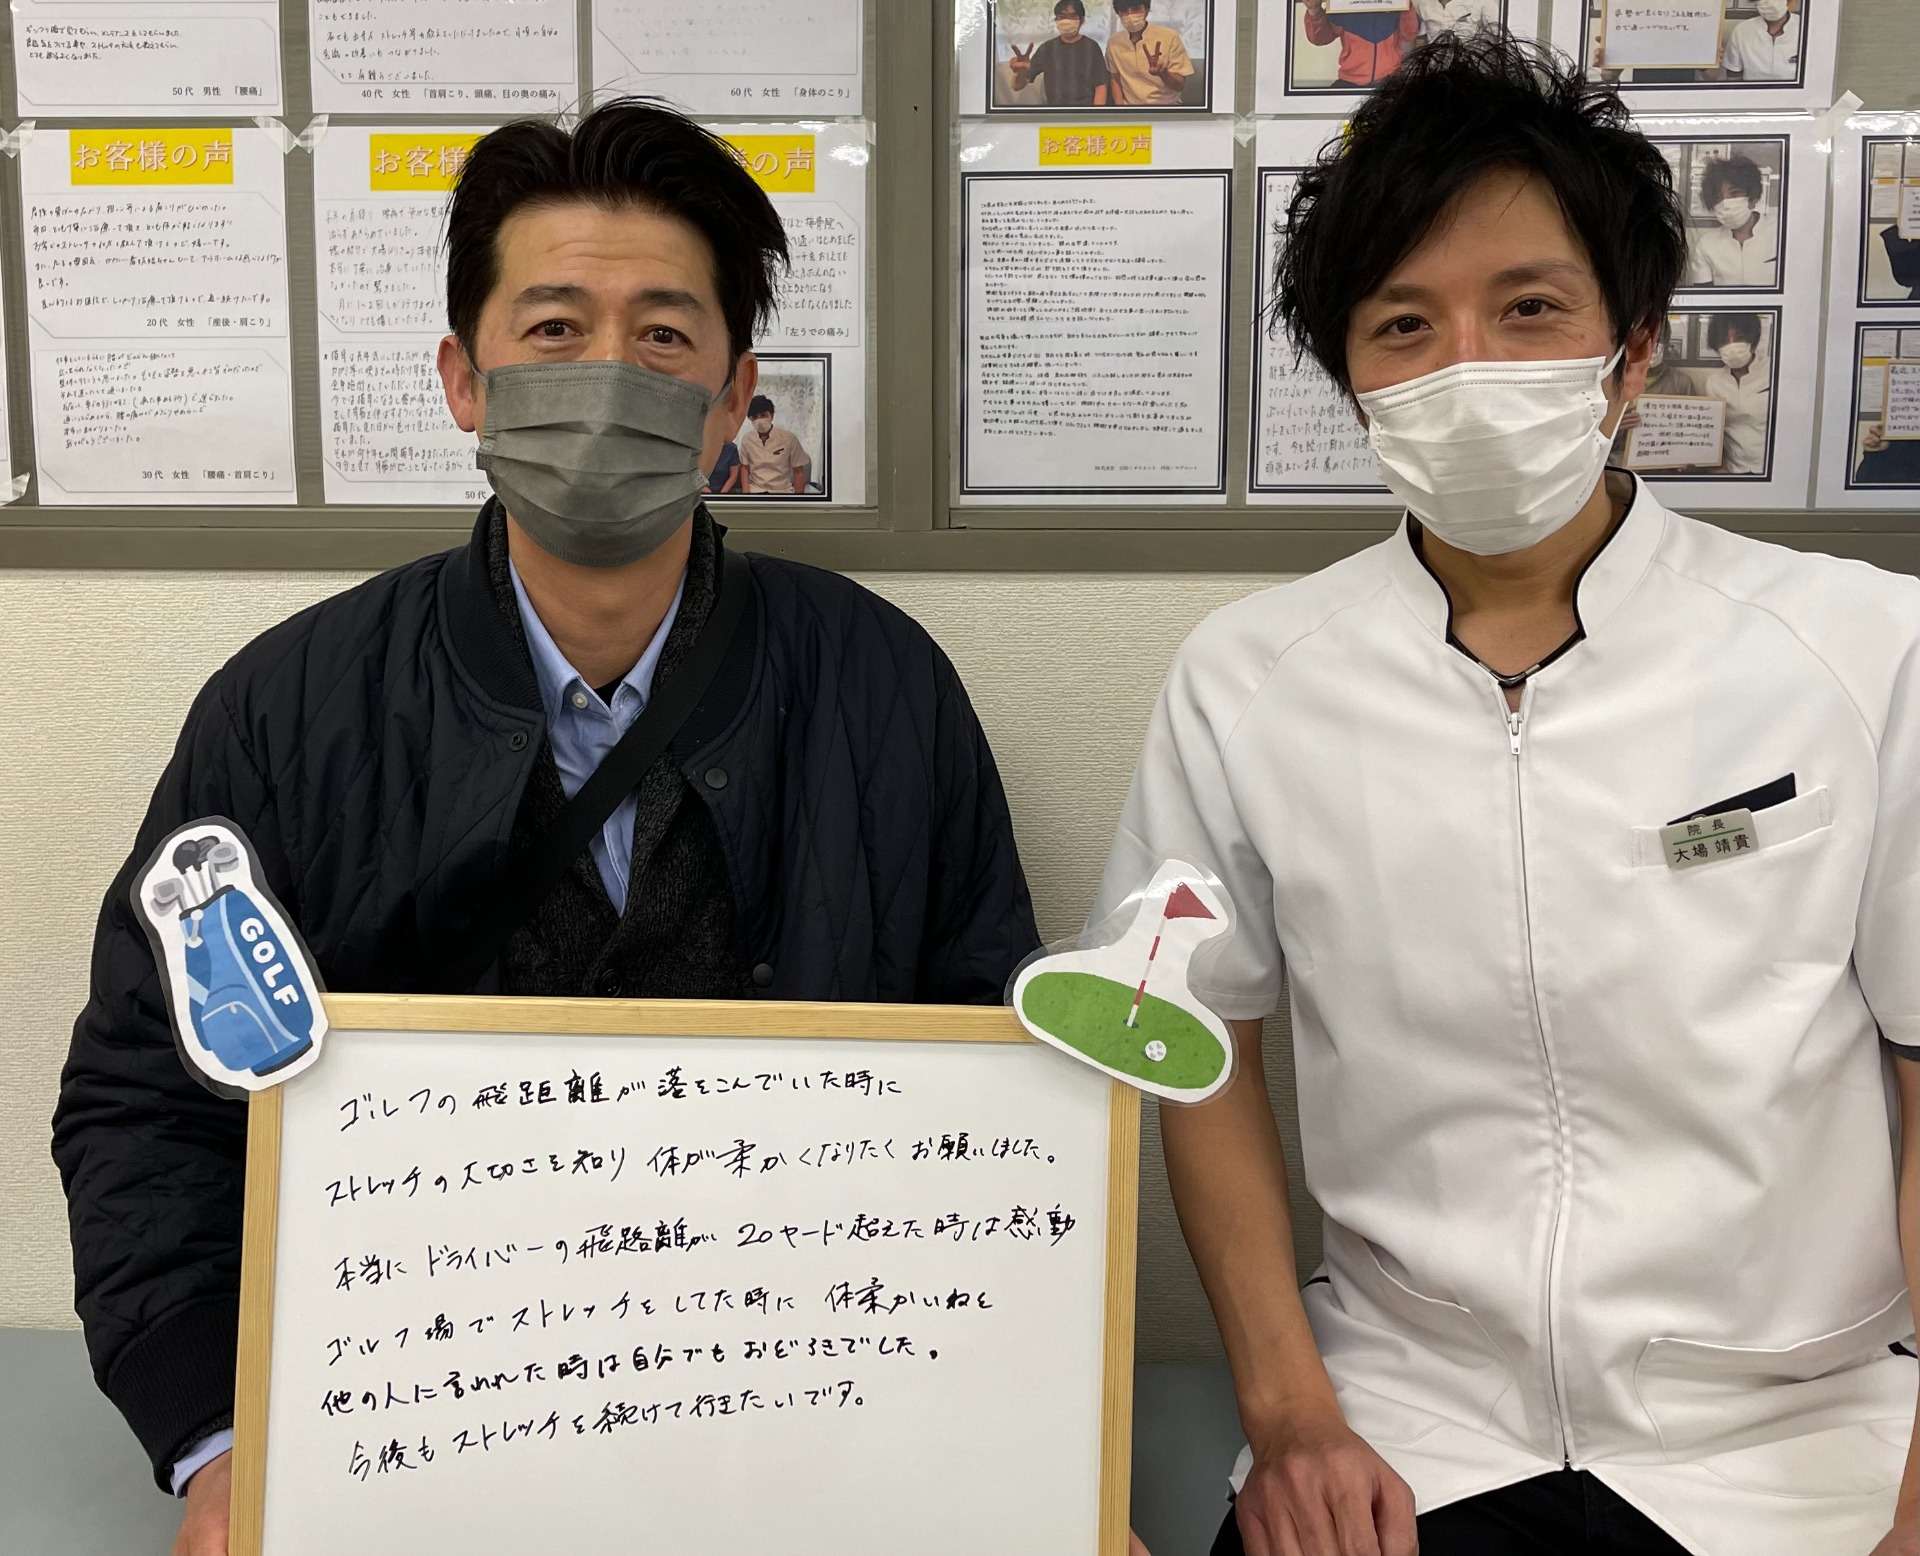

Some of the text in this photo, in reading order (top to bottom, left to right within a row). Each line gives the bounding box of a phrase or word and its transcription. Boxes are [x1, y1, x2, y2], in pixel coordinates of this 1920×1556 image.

[172, 86, 195, 97] 50代
[202, 85, 222, 97] 男性
[360, 88, 384, 100] 40代
[391, 88, 411, 100] 女性
[730, 86, 850, 99] 60代 女性 「身体のこり」
[1042, 133, 1151, 158] お客様の声
[75, 140, 233, 172] お客様の声
[146, 317, 169, 328] 20代
[176, 316, 195, 328] 女性
[141, 469, 164, 480] 30代
[171, 469, 191, 481] 女性
[464, 488, 489, 503] 50代
[1673, 842, 1710, 864] 大場
[240, 917, 299, 1006] GOLF
[333, 1253, 408, 1292] 本当に
[347, 1435, 435, 1483] 今後も
